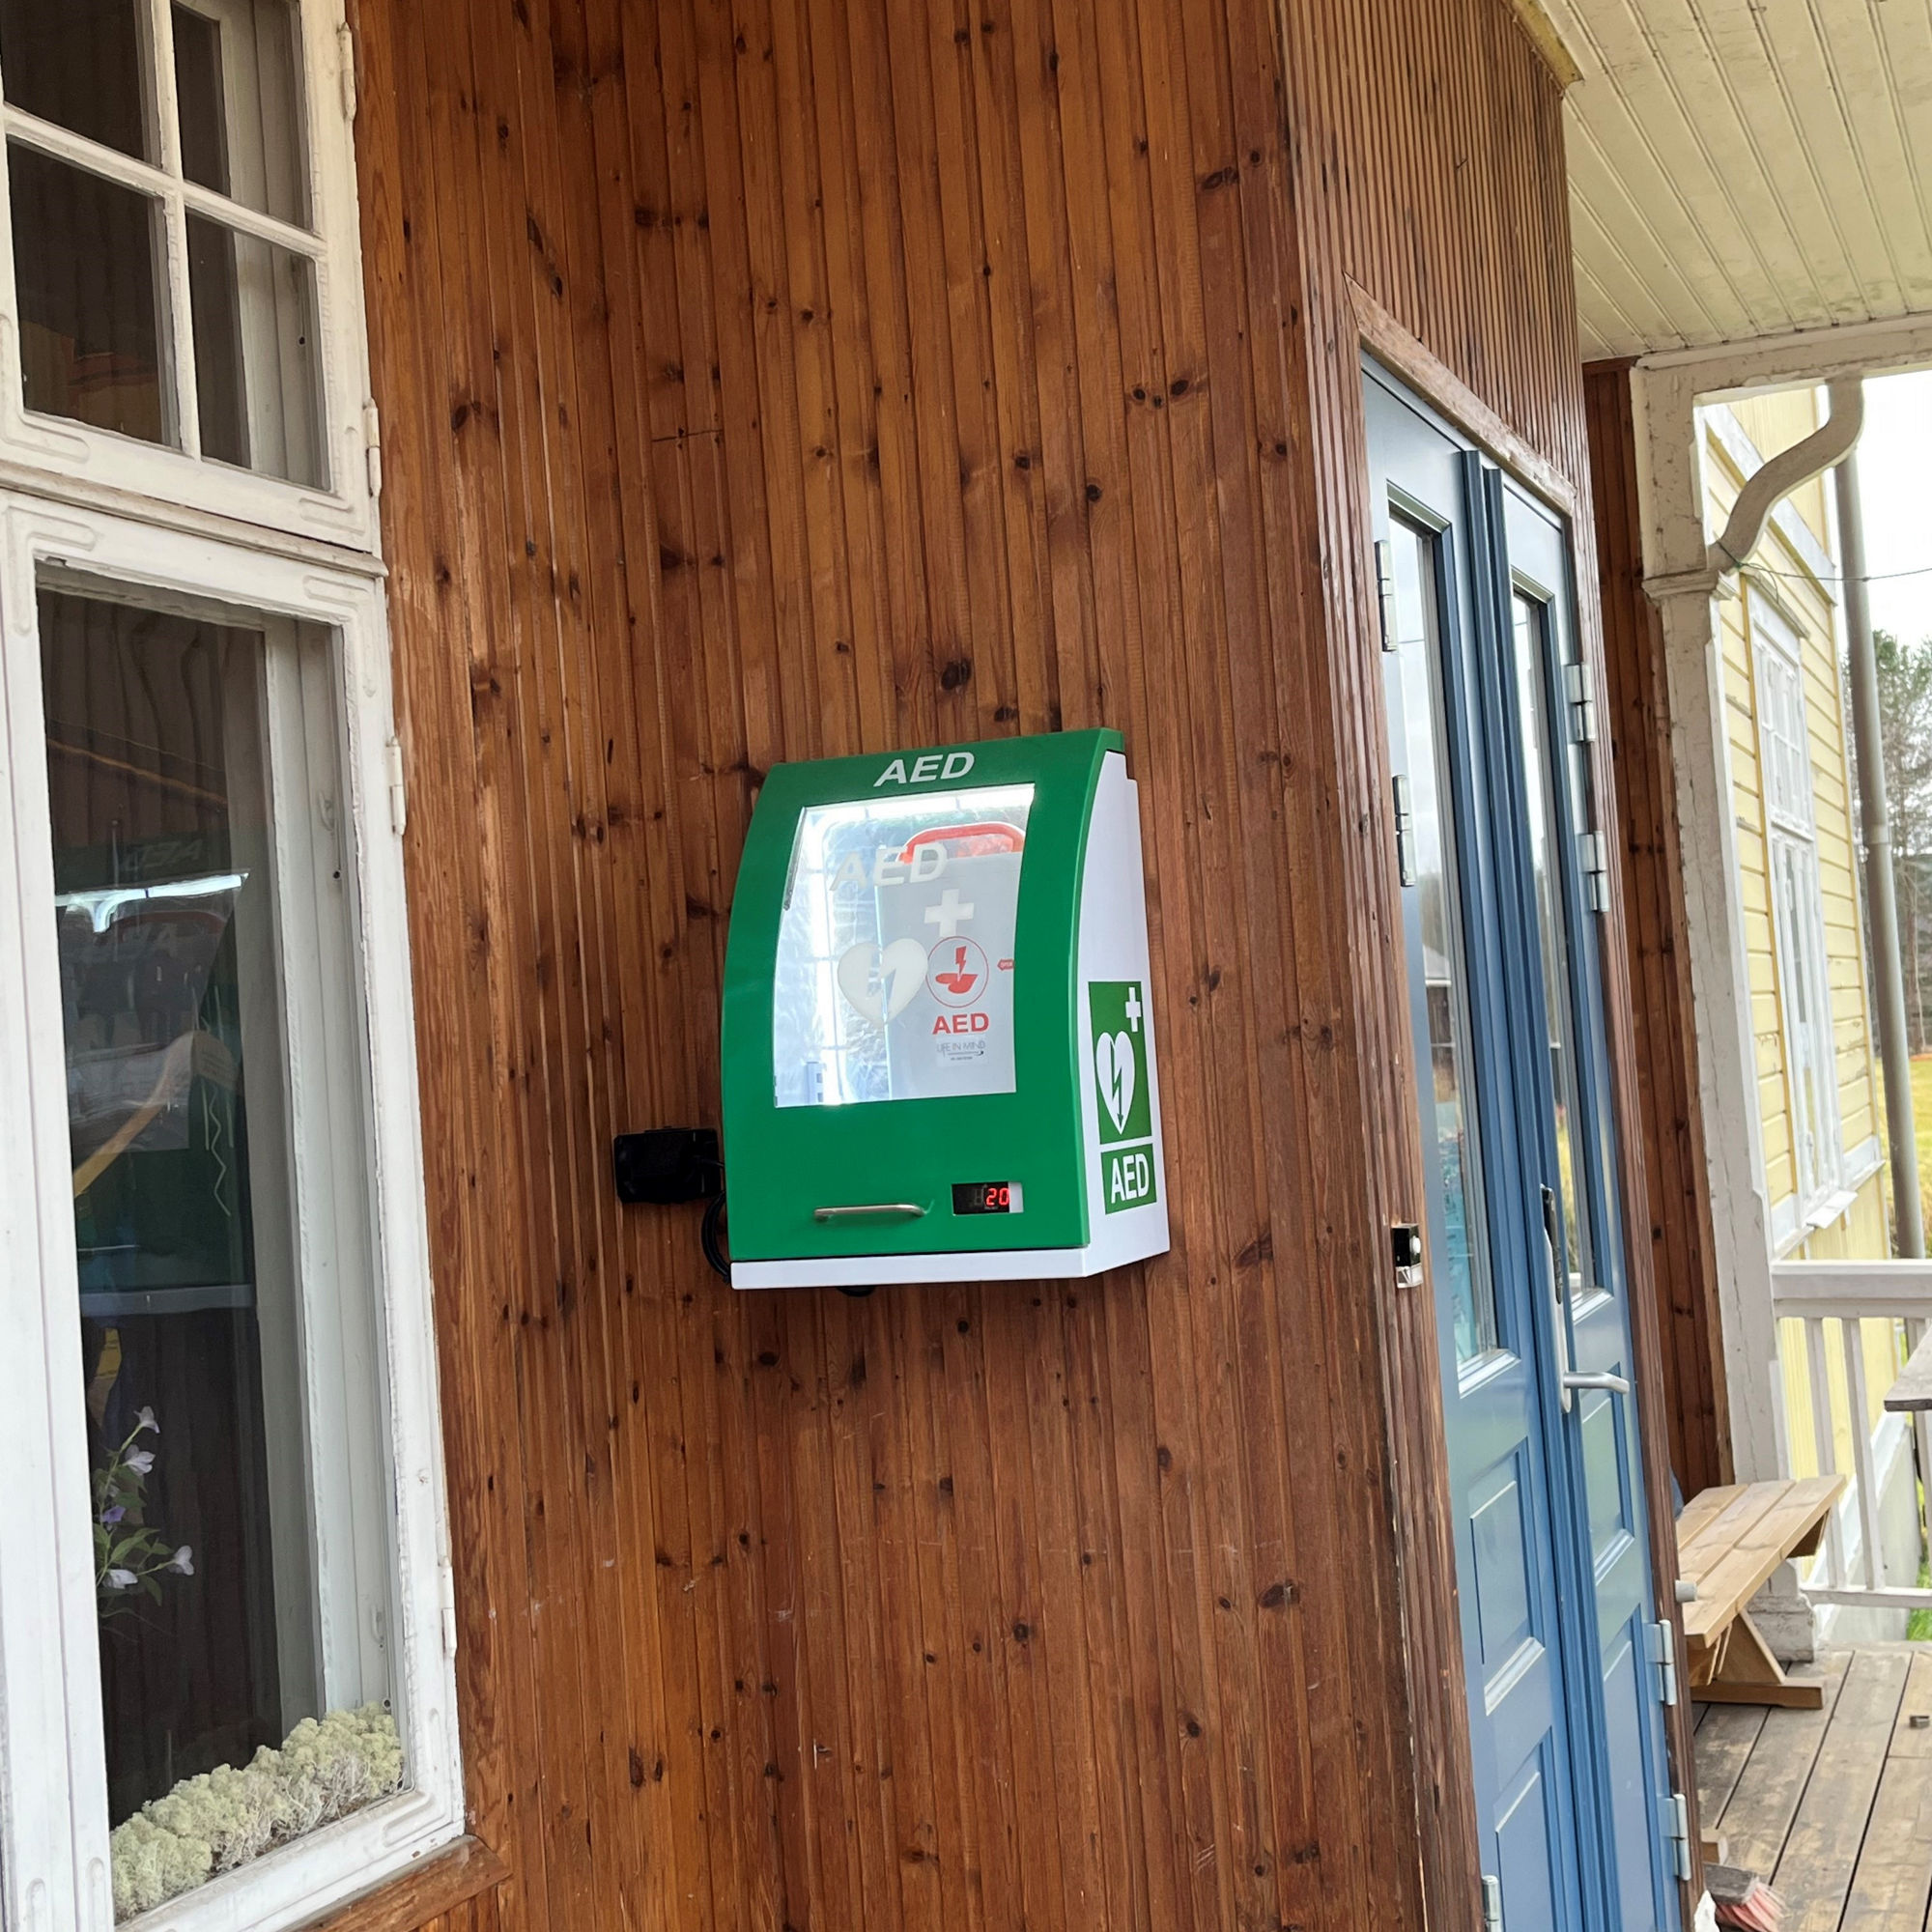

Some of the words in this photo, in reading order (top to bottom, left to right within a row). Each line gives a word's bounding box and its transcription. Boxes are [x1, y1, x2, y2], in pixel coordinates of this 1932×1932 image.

[873, 752, 975, 787] AED
[829, 842, 948, 891] AED
[932, 1012, 990, 1035] AED
[1111, 1152, 1150, 1205] AED
[986, 1187, 1010, 1206] 20
